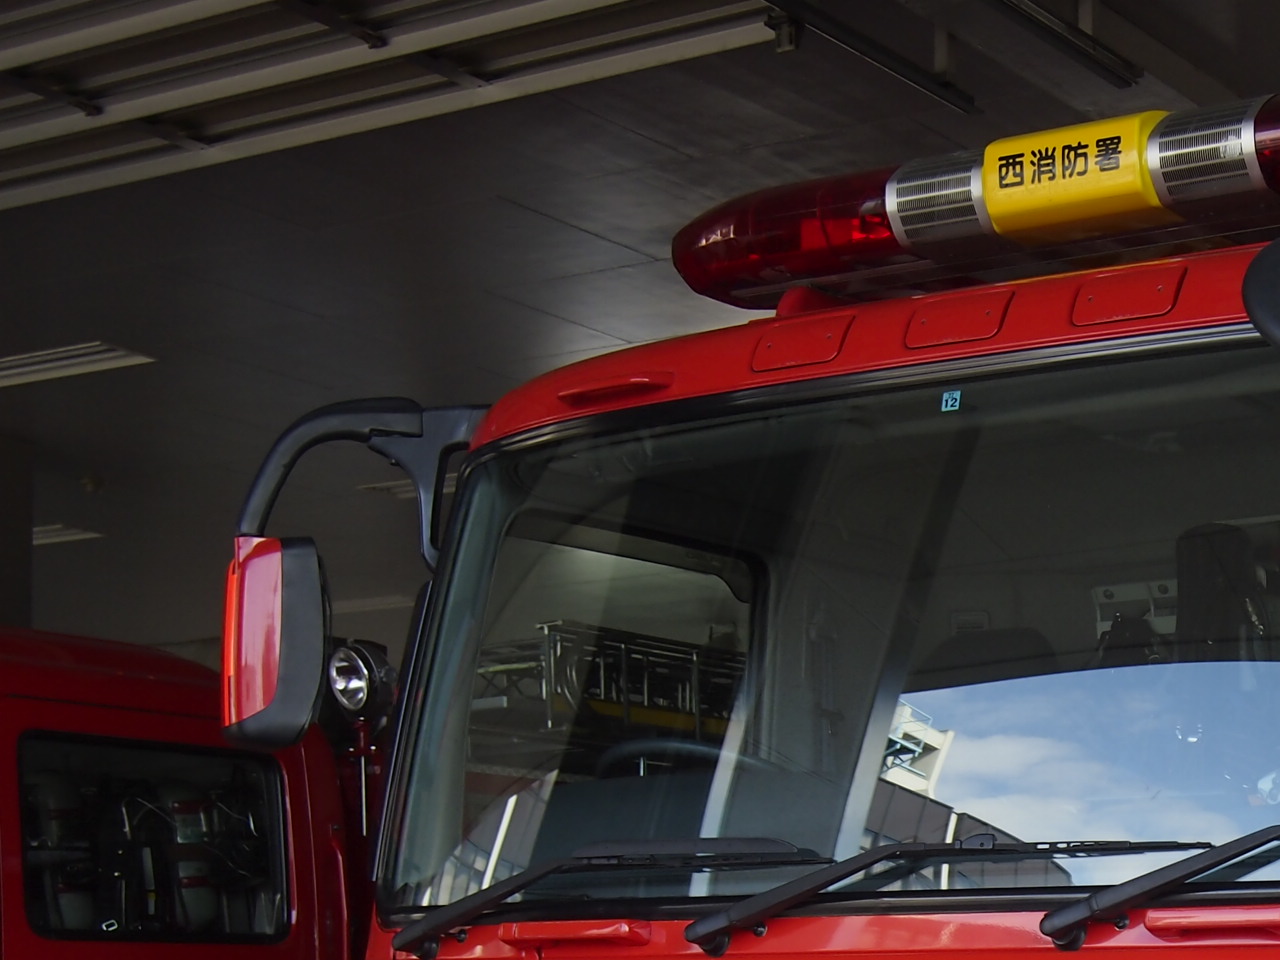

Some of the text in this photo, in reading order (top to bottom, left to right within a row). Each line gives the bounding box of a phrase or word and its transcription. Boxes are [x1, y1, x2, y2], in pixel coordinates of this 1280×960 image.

[998, 135, 1122, 189] 西消防署
[944, 397, 958, 409] 12
